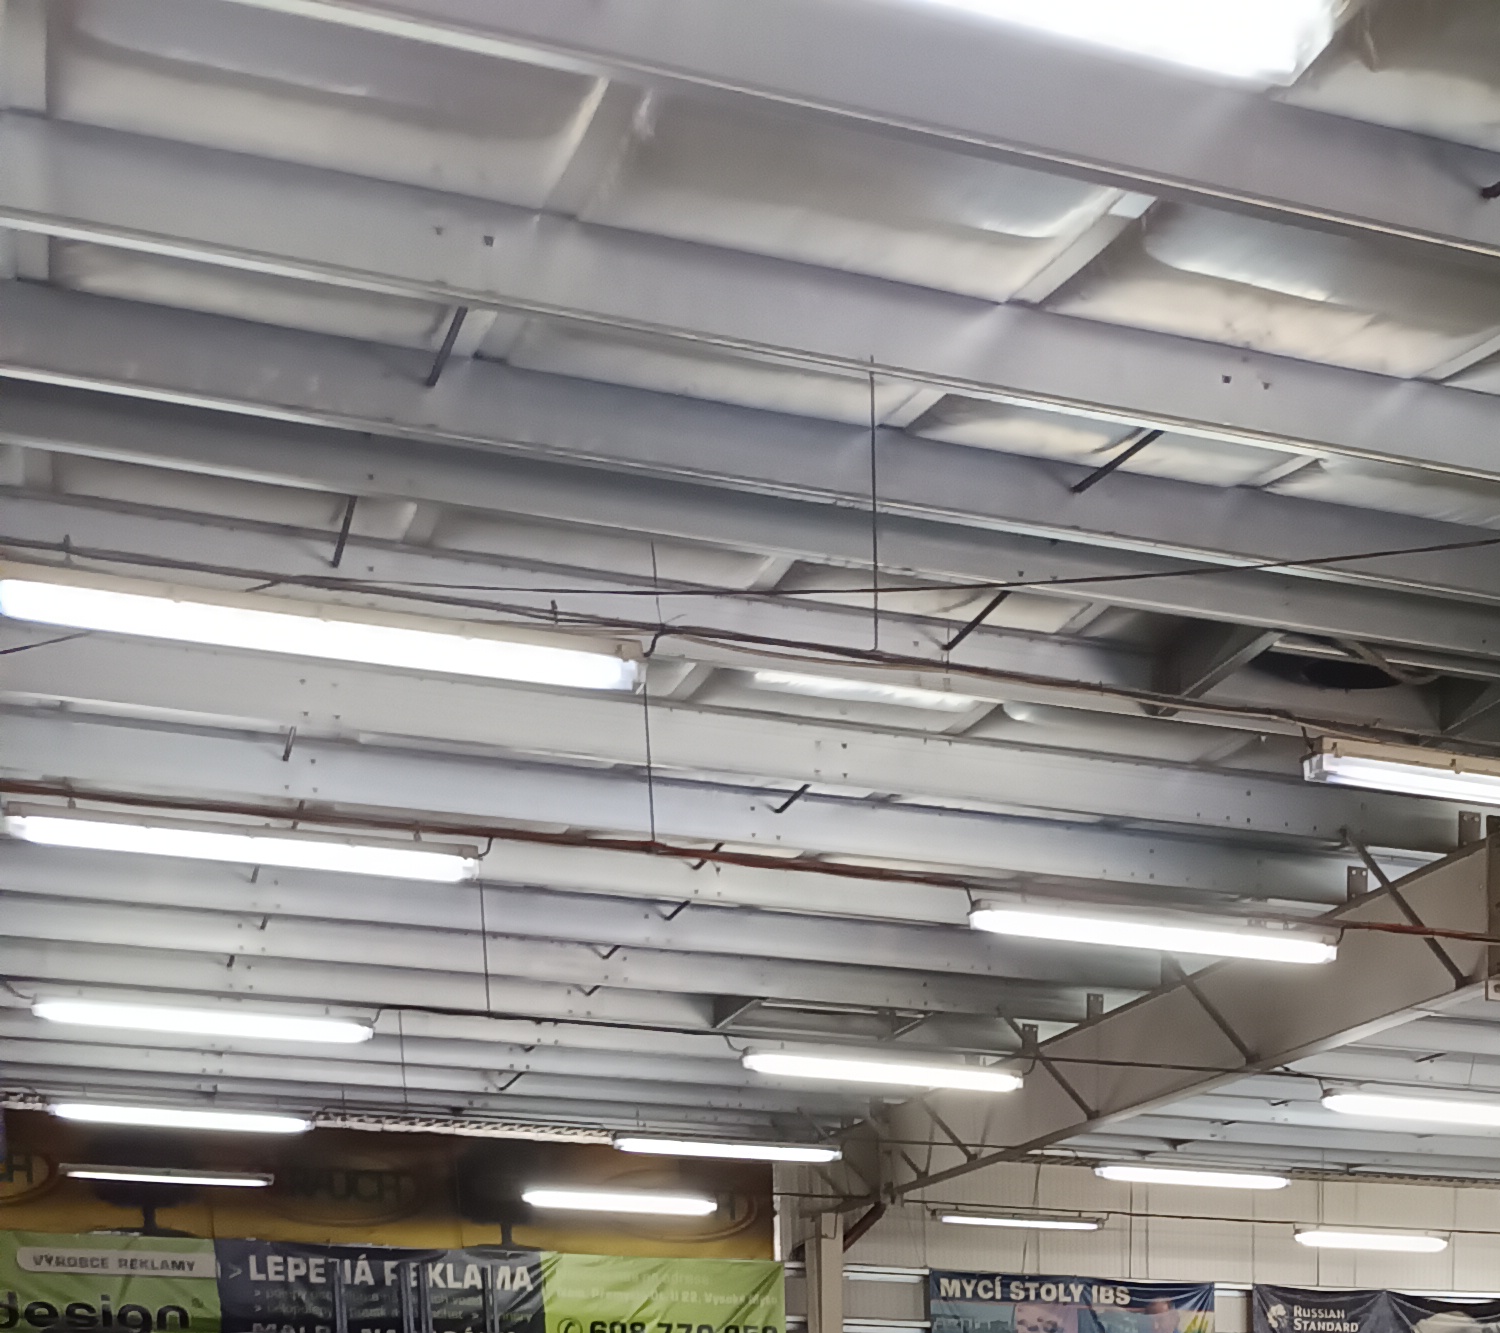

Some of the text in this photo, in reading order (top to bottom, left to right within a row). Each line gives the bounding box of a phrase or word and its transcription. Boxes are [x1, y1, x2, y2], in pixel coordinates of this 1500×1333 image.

[118, 1257, 196, 1273] REKLAMY
[939, 1277, 1131, 1305] MYCÍ STOLY IBS
[1293, 1318, 1359, 1333] STANDARD
